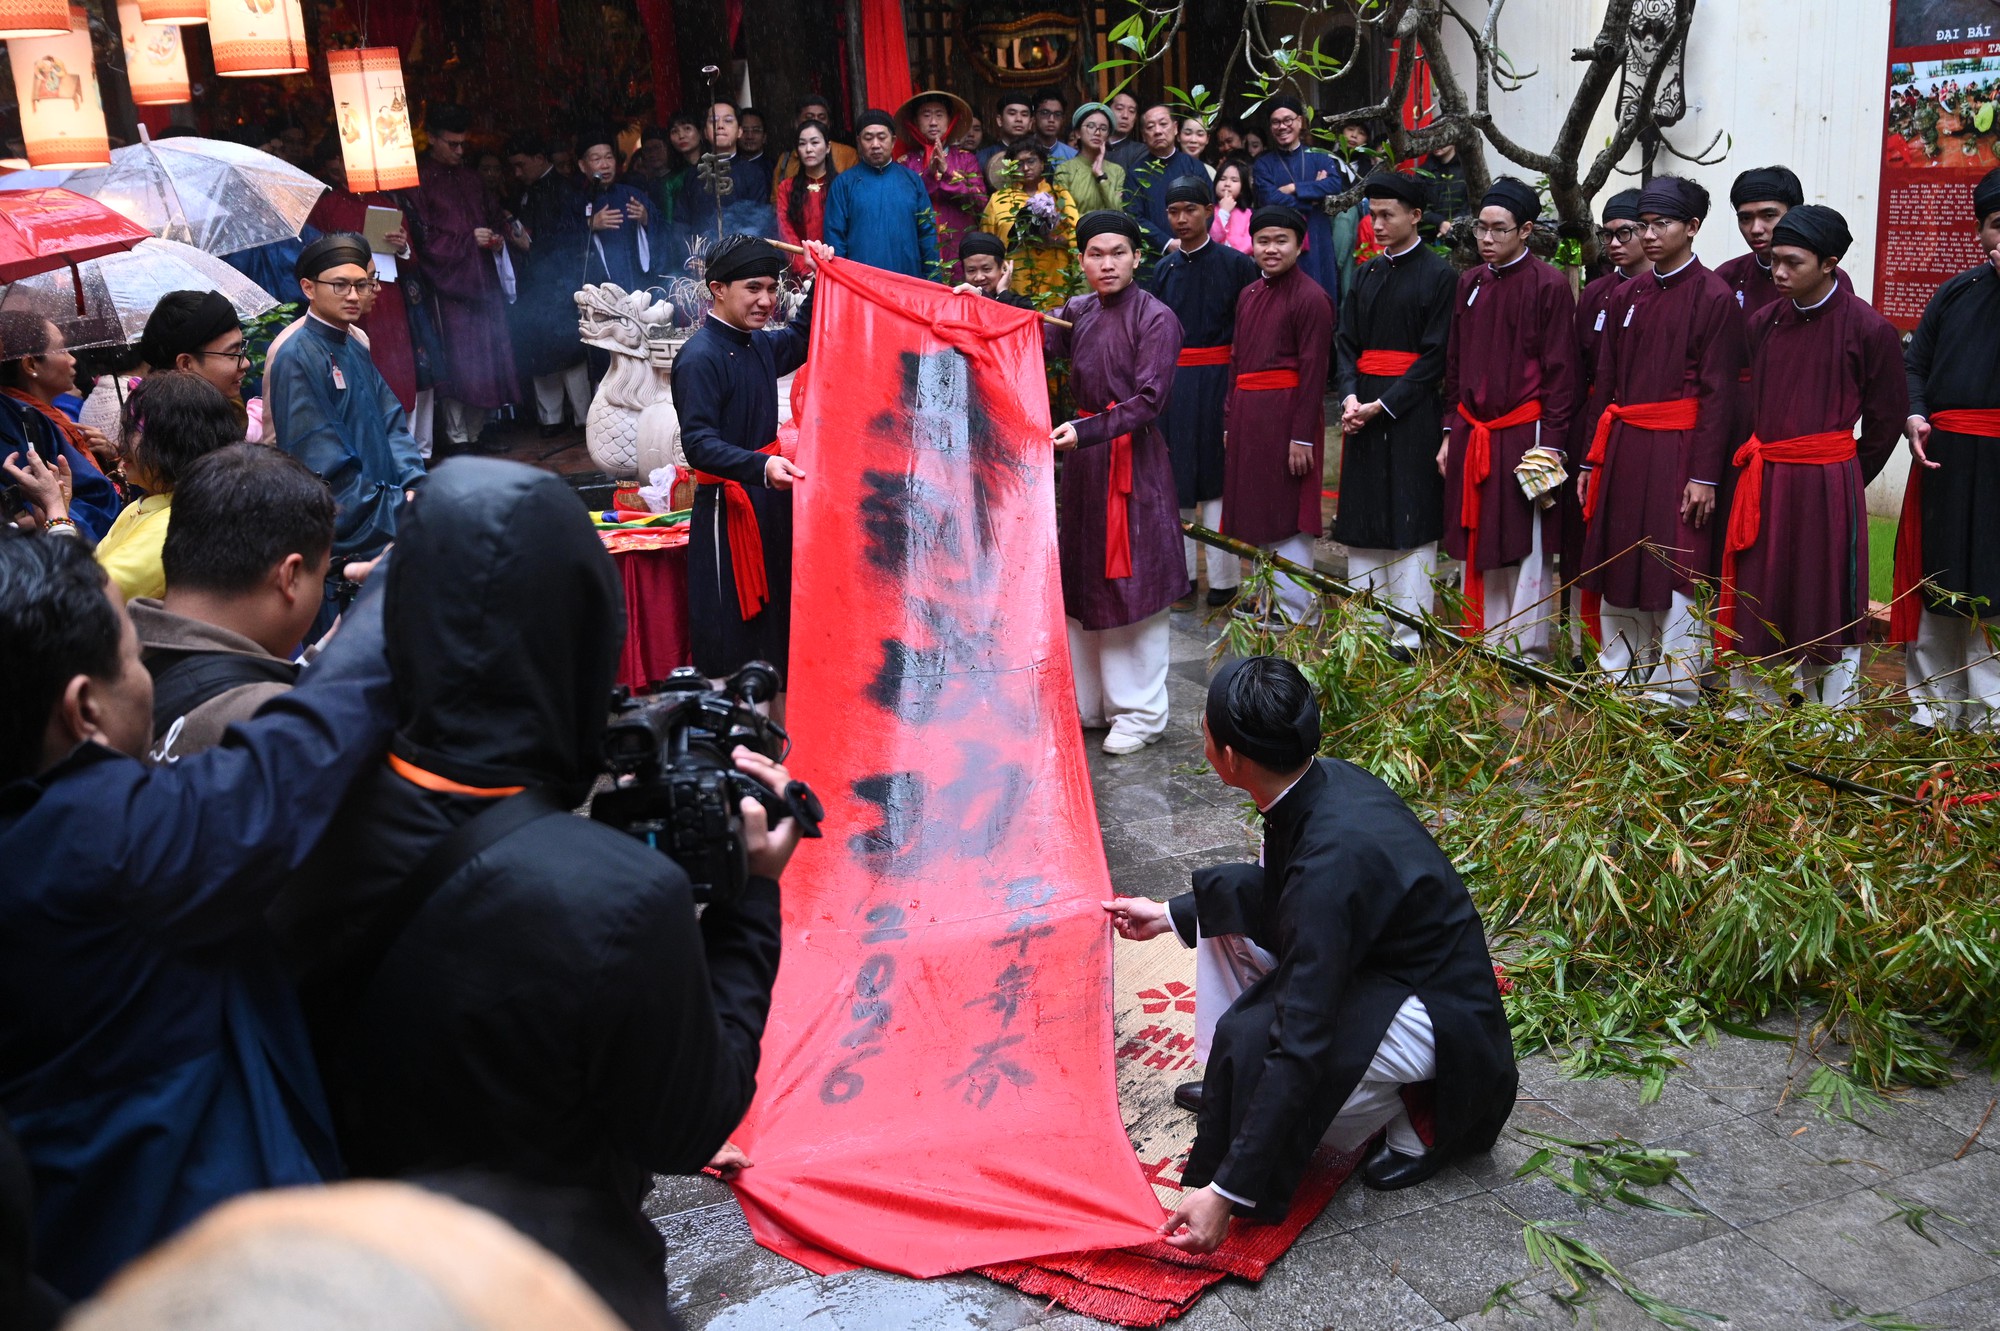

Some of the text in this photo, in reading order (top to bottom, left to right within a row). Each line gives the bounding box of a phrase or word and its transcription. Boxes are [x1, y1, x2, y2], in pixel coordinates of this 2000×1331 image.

[1936, 23, 1992, 43] ĐẠI BÁI
[818, 903, 908, 1106] 2026
